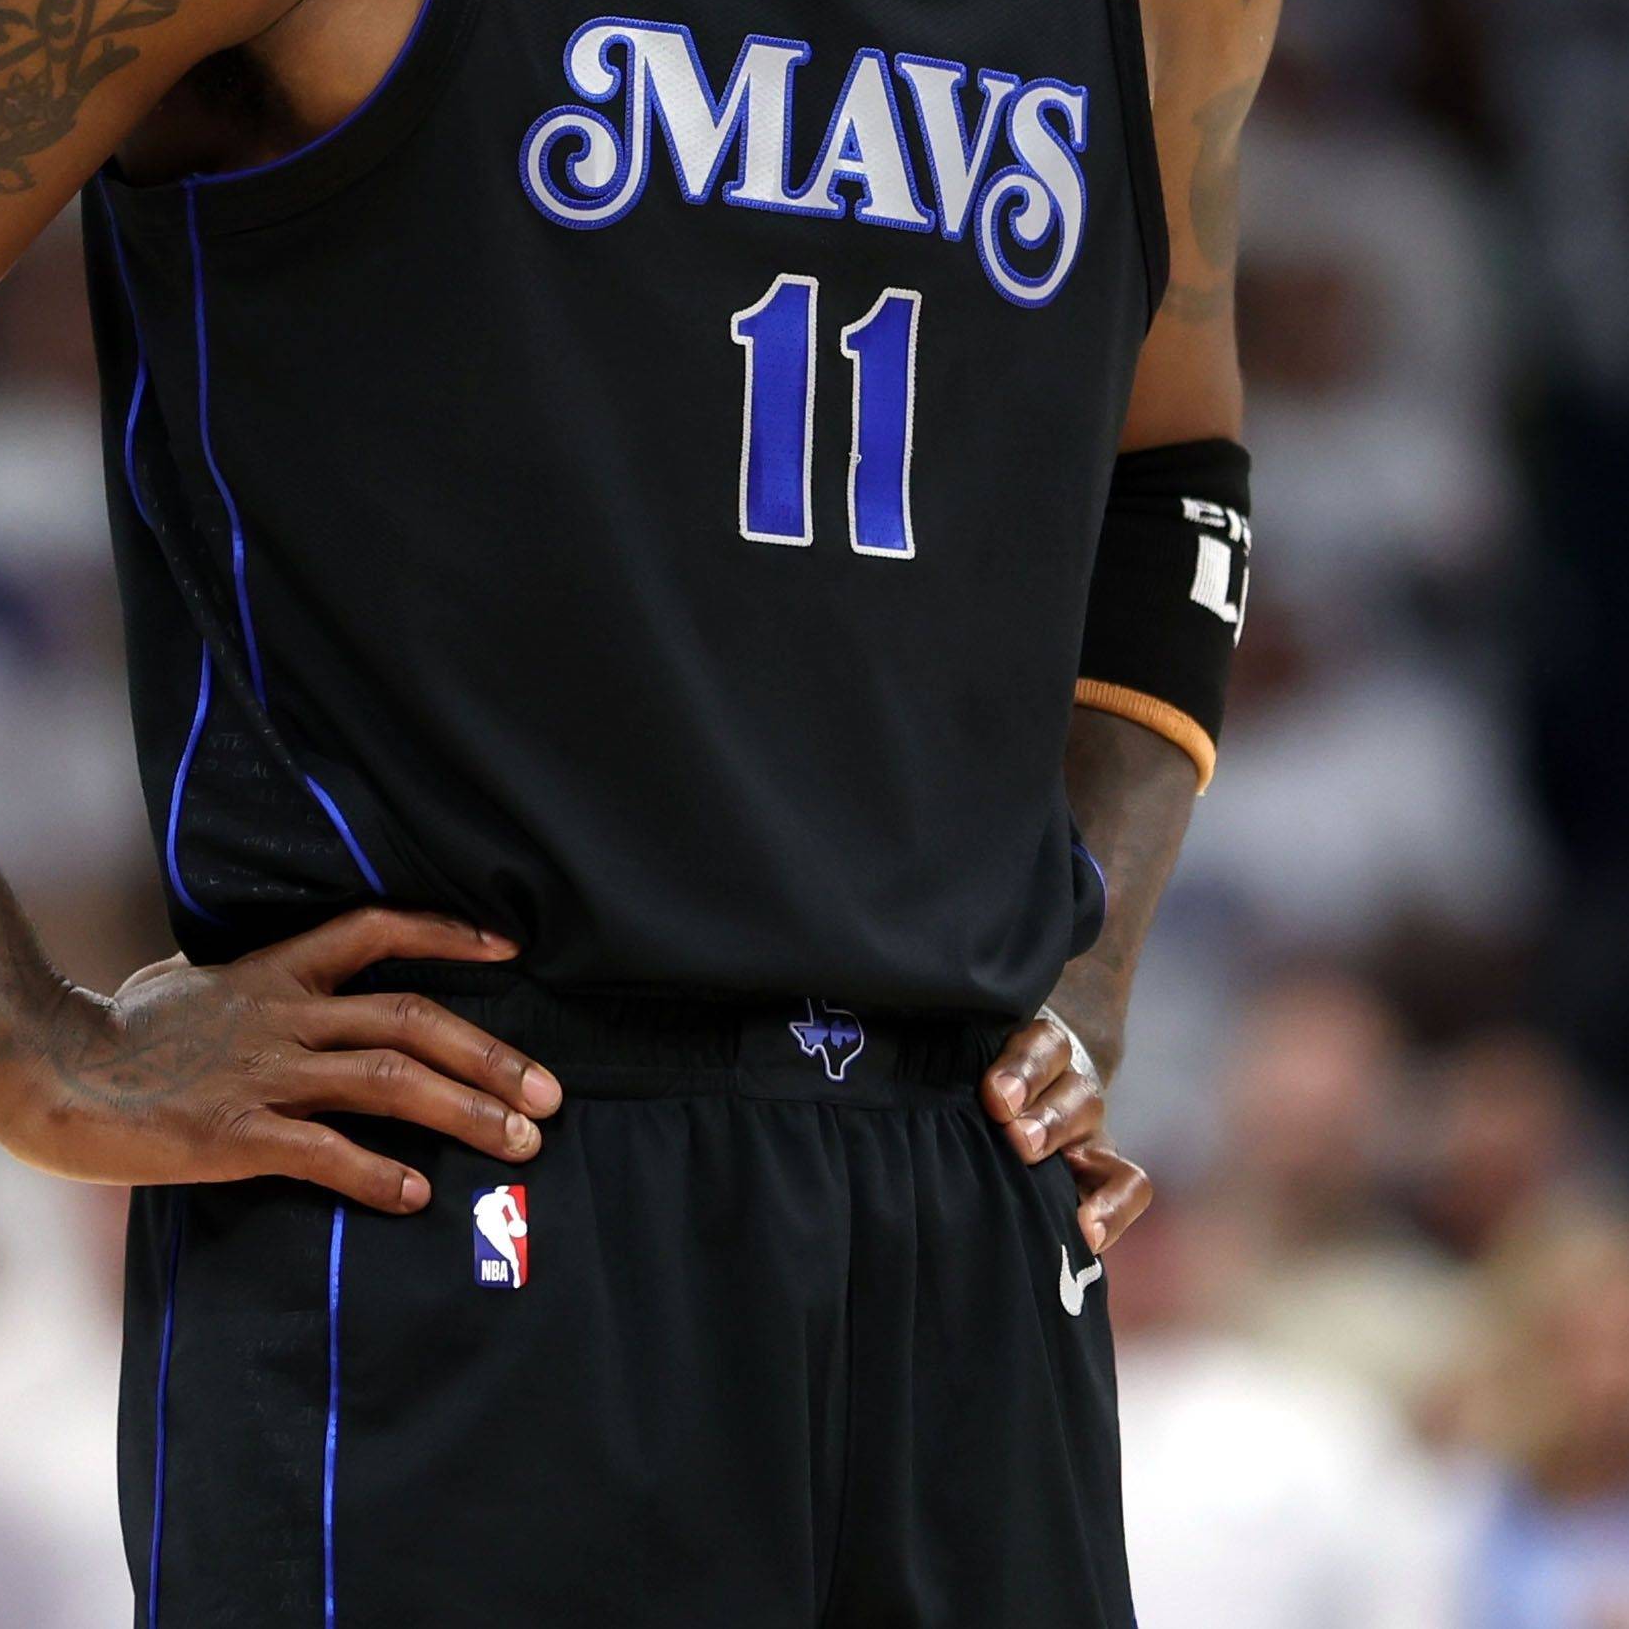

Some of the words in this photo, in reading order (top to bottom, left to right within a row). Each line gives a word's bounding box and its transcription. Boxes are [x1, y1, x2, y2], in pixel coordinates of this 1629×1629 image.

[521, 16, 1087, 309] MAVS
[732, 274, 923, 559] 11
[481, 1259, 509, 1282] NBA
